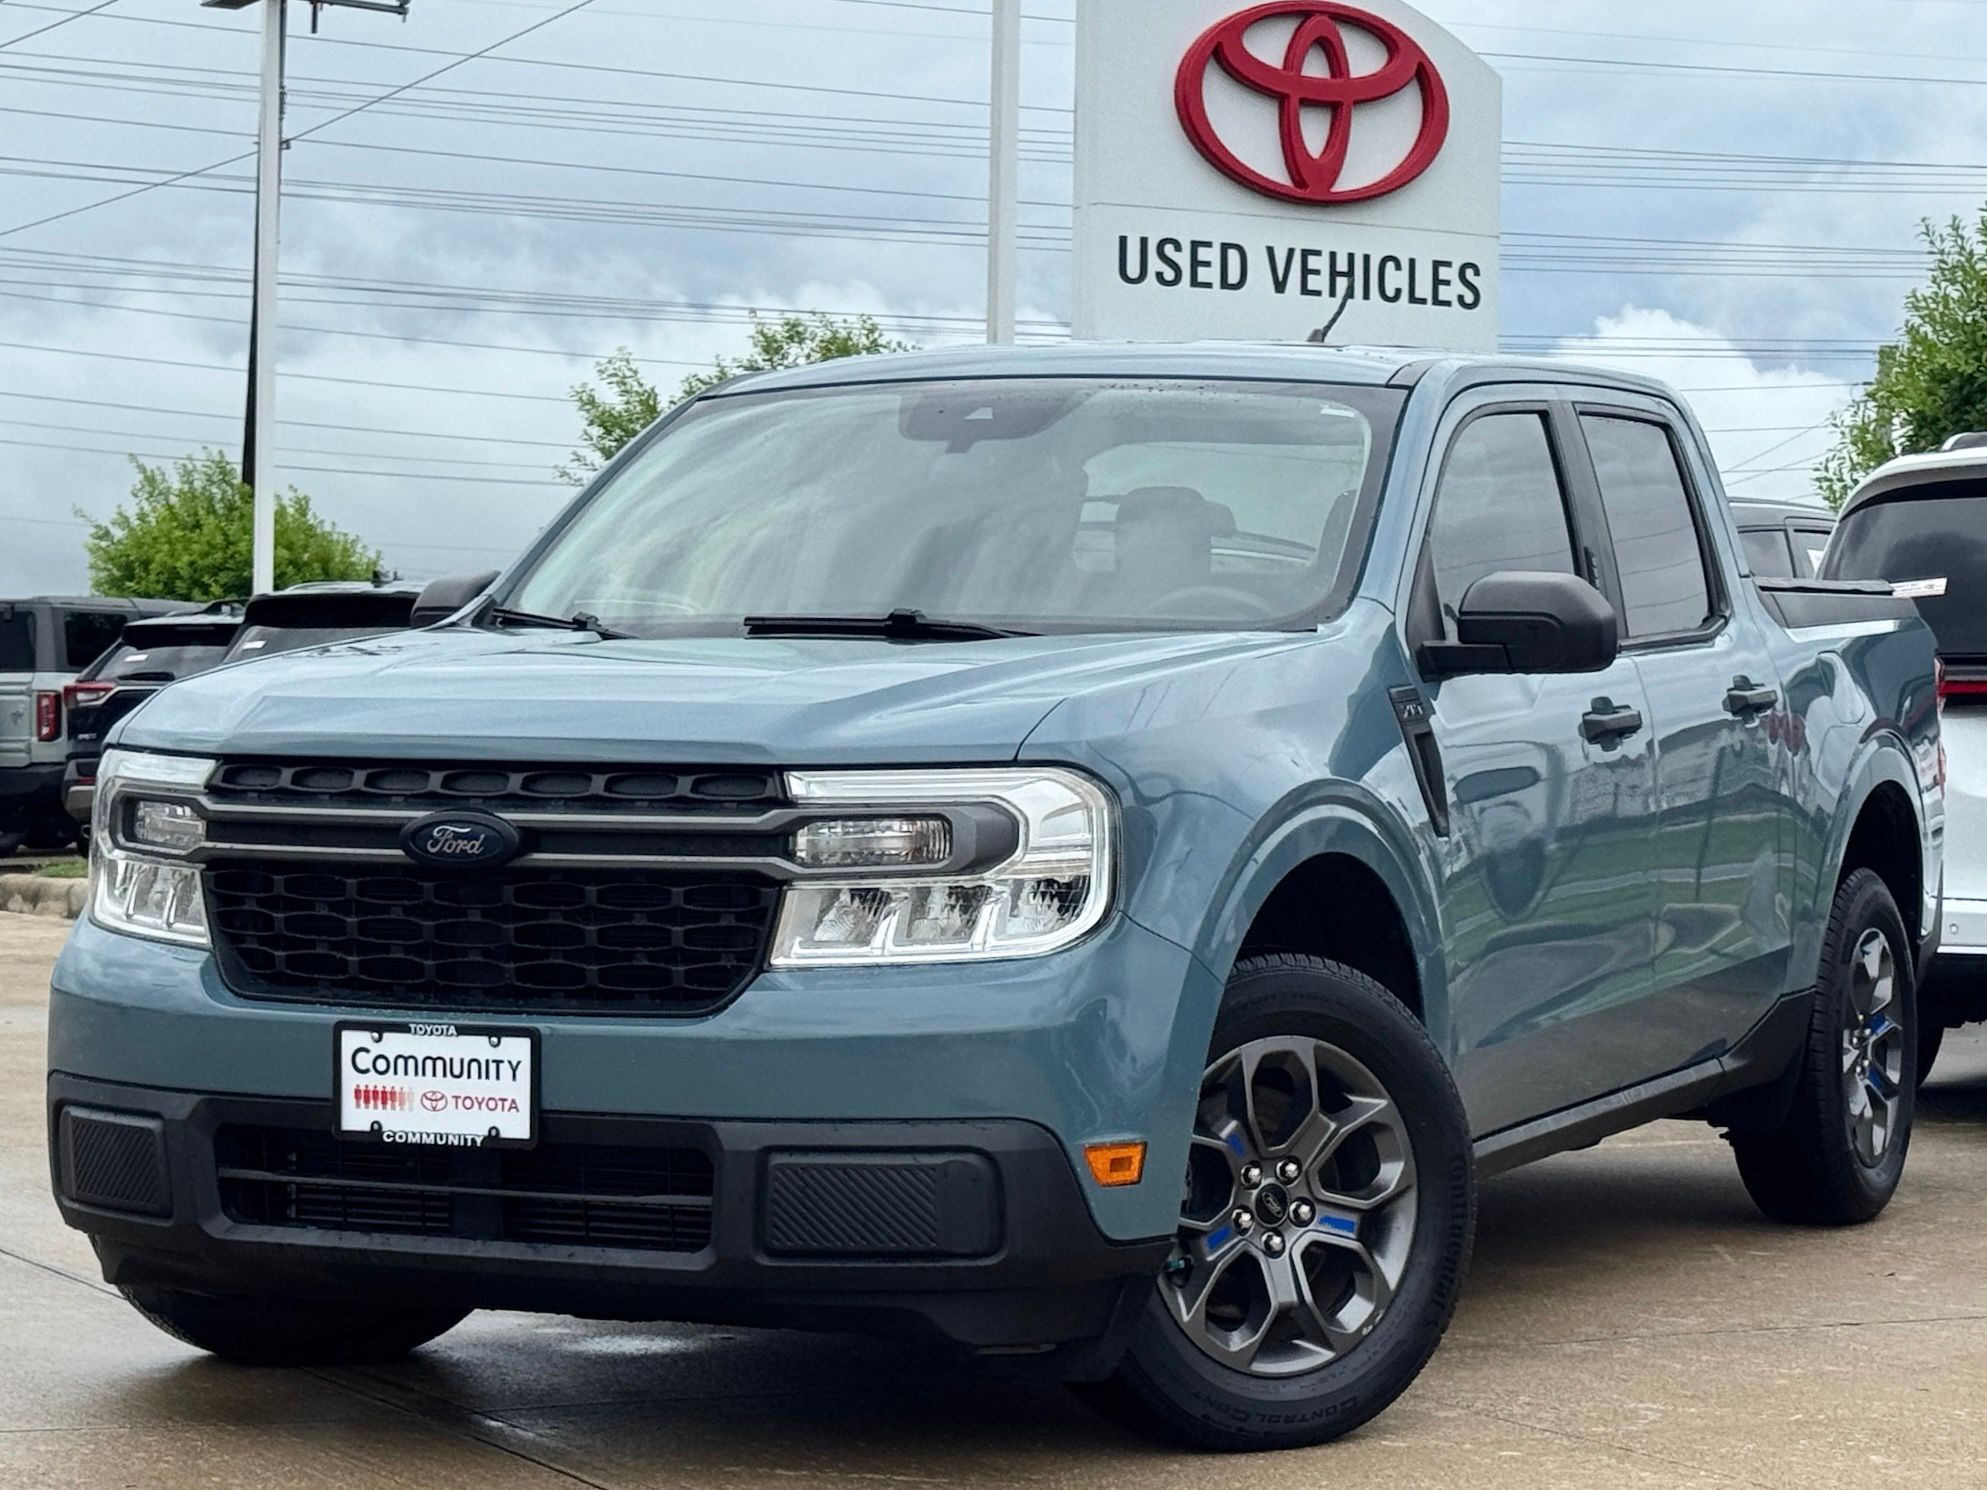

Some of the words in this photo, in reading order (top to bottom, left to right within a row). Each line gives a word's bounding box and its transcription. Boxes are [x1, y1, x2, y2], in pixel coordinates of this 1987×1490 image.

[1117, 234, 1249, 292] USED
[1265, 245, 1482, 312] VEHICLES
[426, 825, 486, 855] Ford
[408, 1023, 458, 1037] TOYOTA
[452, 1095, 520, 1113] TOYOTA
[382, 1130, 485, 1147] COMMUNITY
